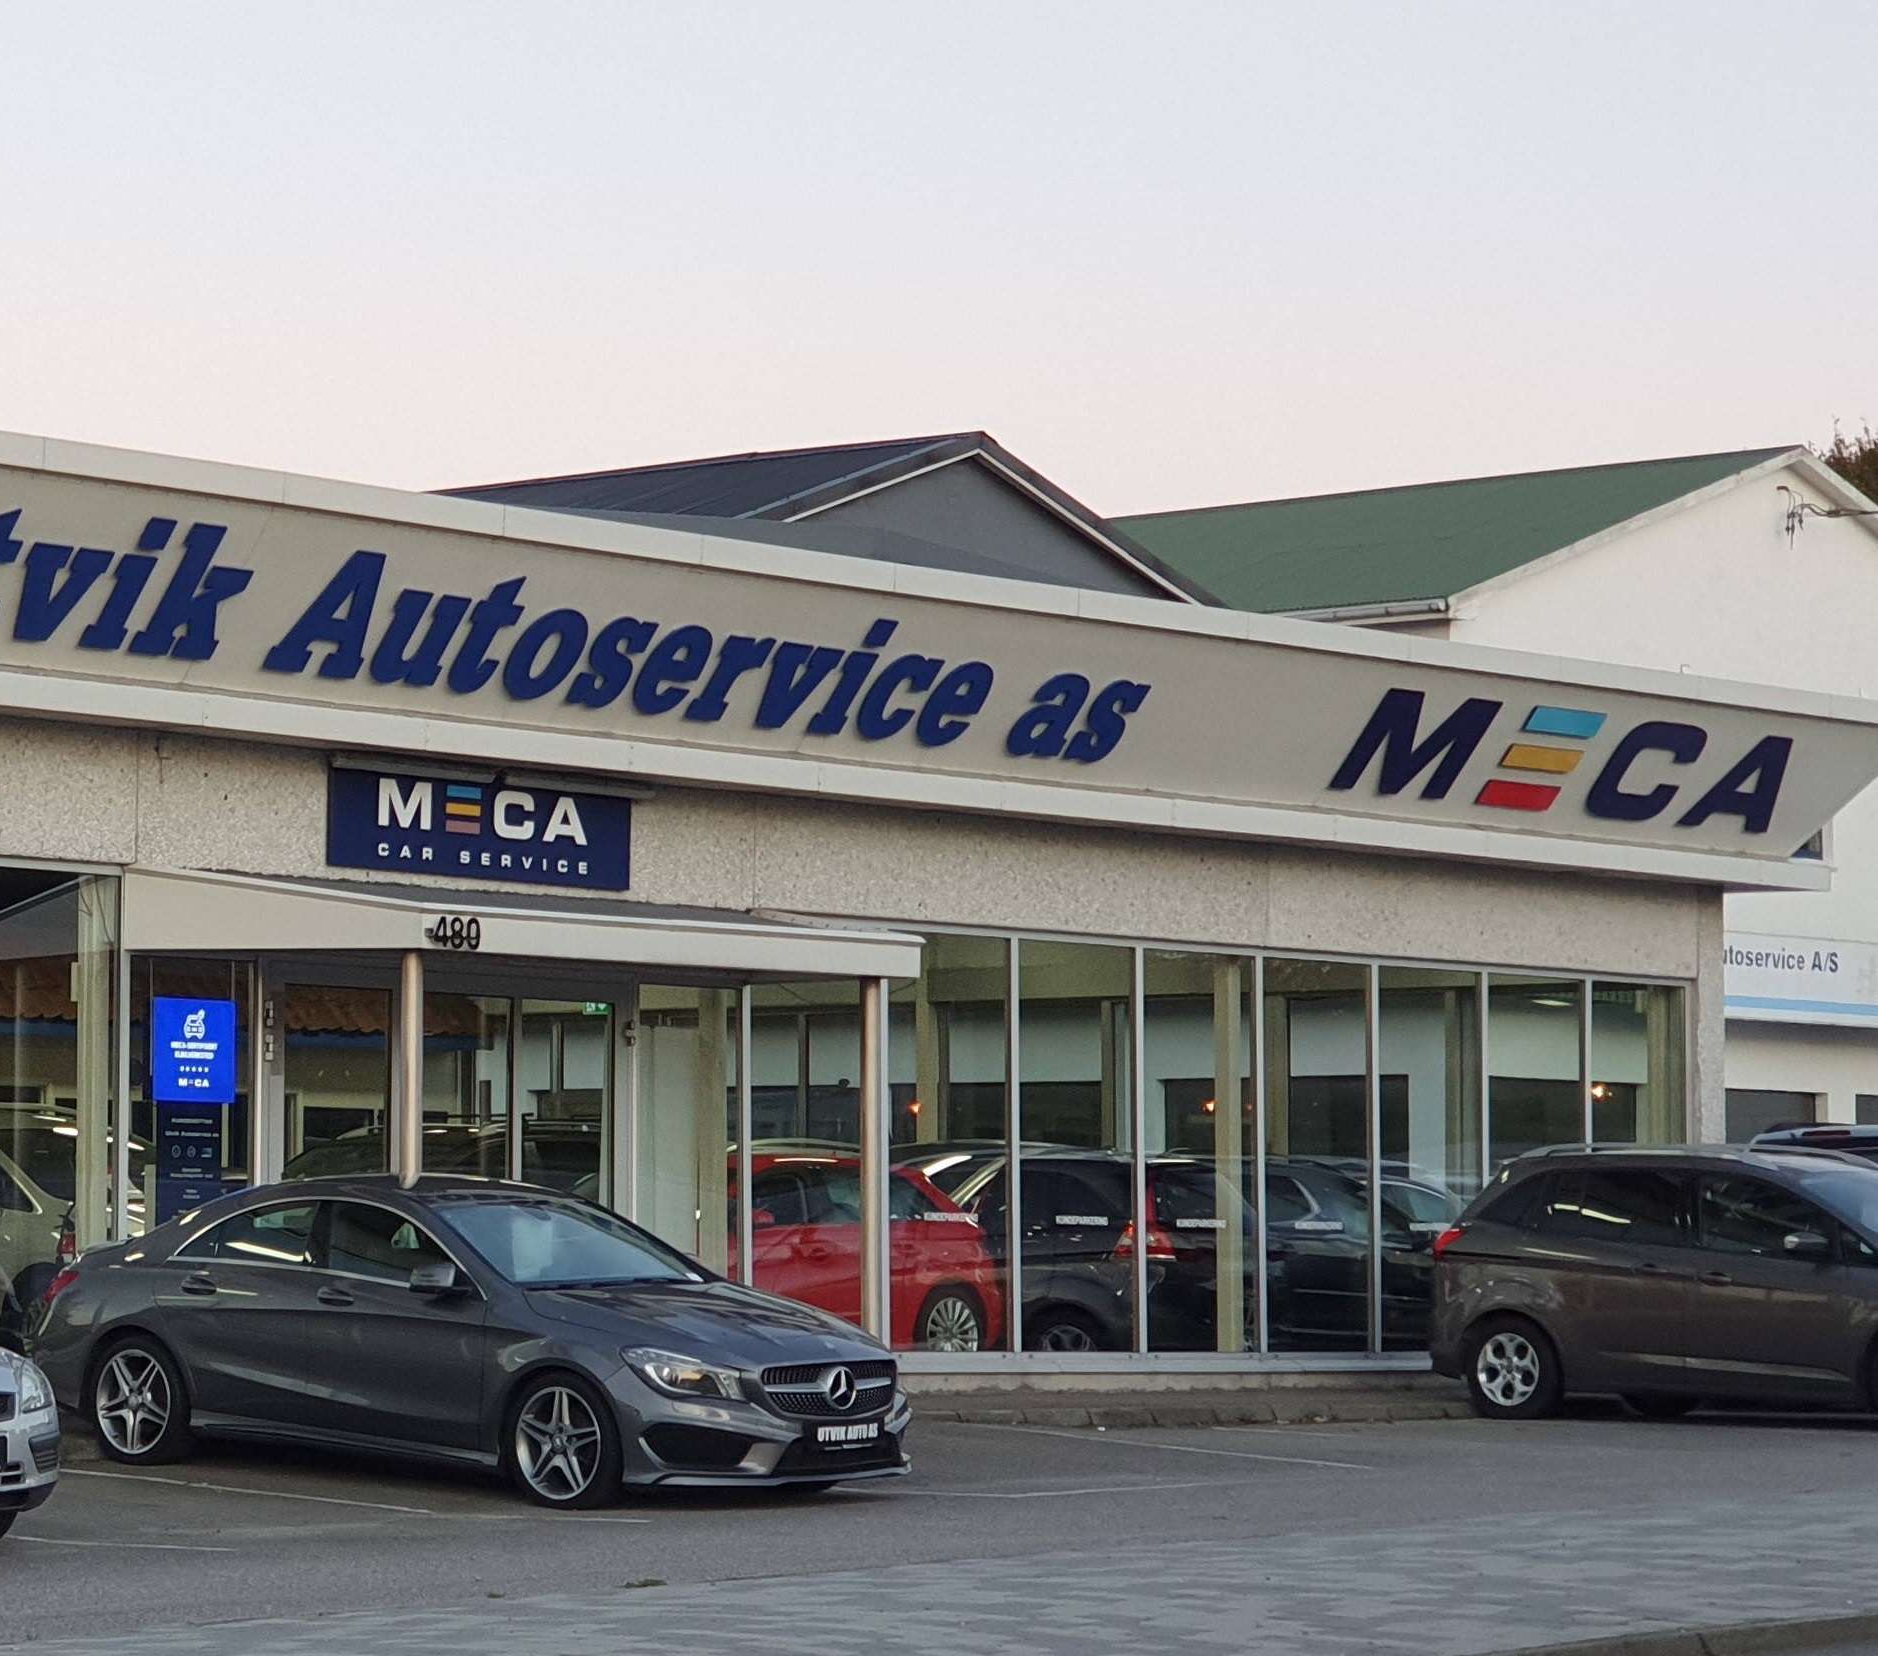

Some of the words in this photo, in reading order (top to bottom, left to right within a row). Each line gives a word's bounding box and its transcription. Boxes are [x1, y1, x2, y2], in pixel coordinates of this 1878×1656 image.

[262, 550, 993, 748] Autoservice
[1006, 672, 1152, 764] as
[1329, 687, 1794, 834] MECA
[377, 777, 589, 846] MECA
[377, 843, 434, 861] CAR
[459, 851, 590, 875] SERVICE
[433, 916, 480, 950] 480
[1811, 950, 1839, 973] A/S
[817, 1426, 846, 1441] UTVIK
[847, 1424, 868, 1440] AUTO
[868, 1422, 878, 1438] AS
